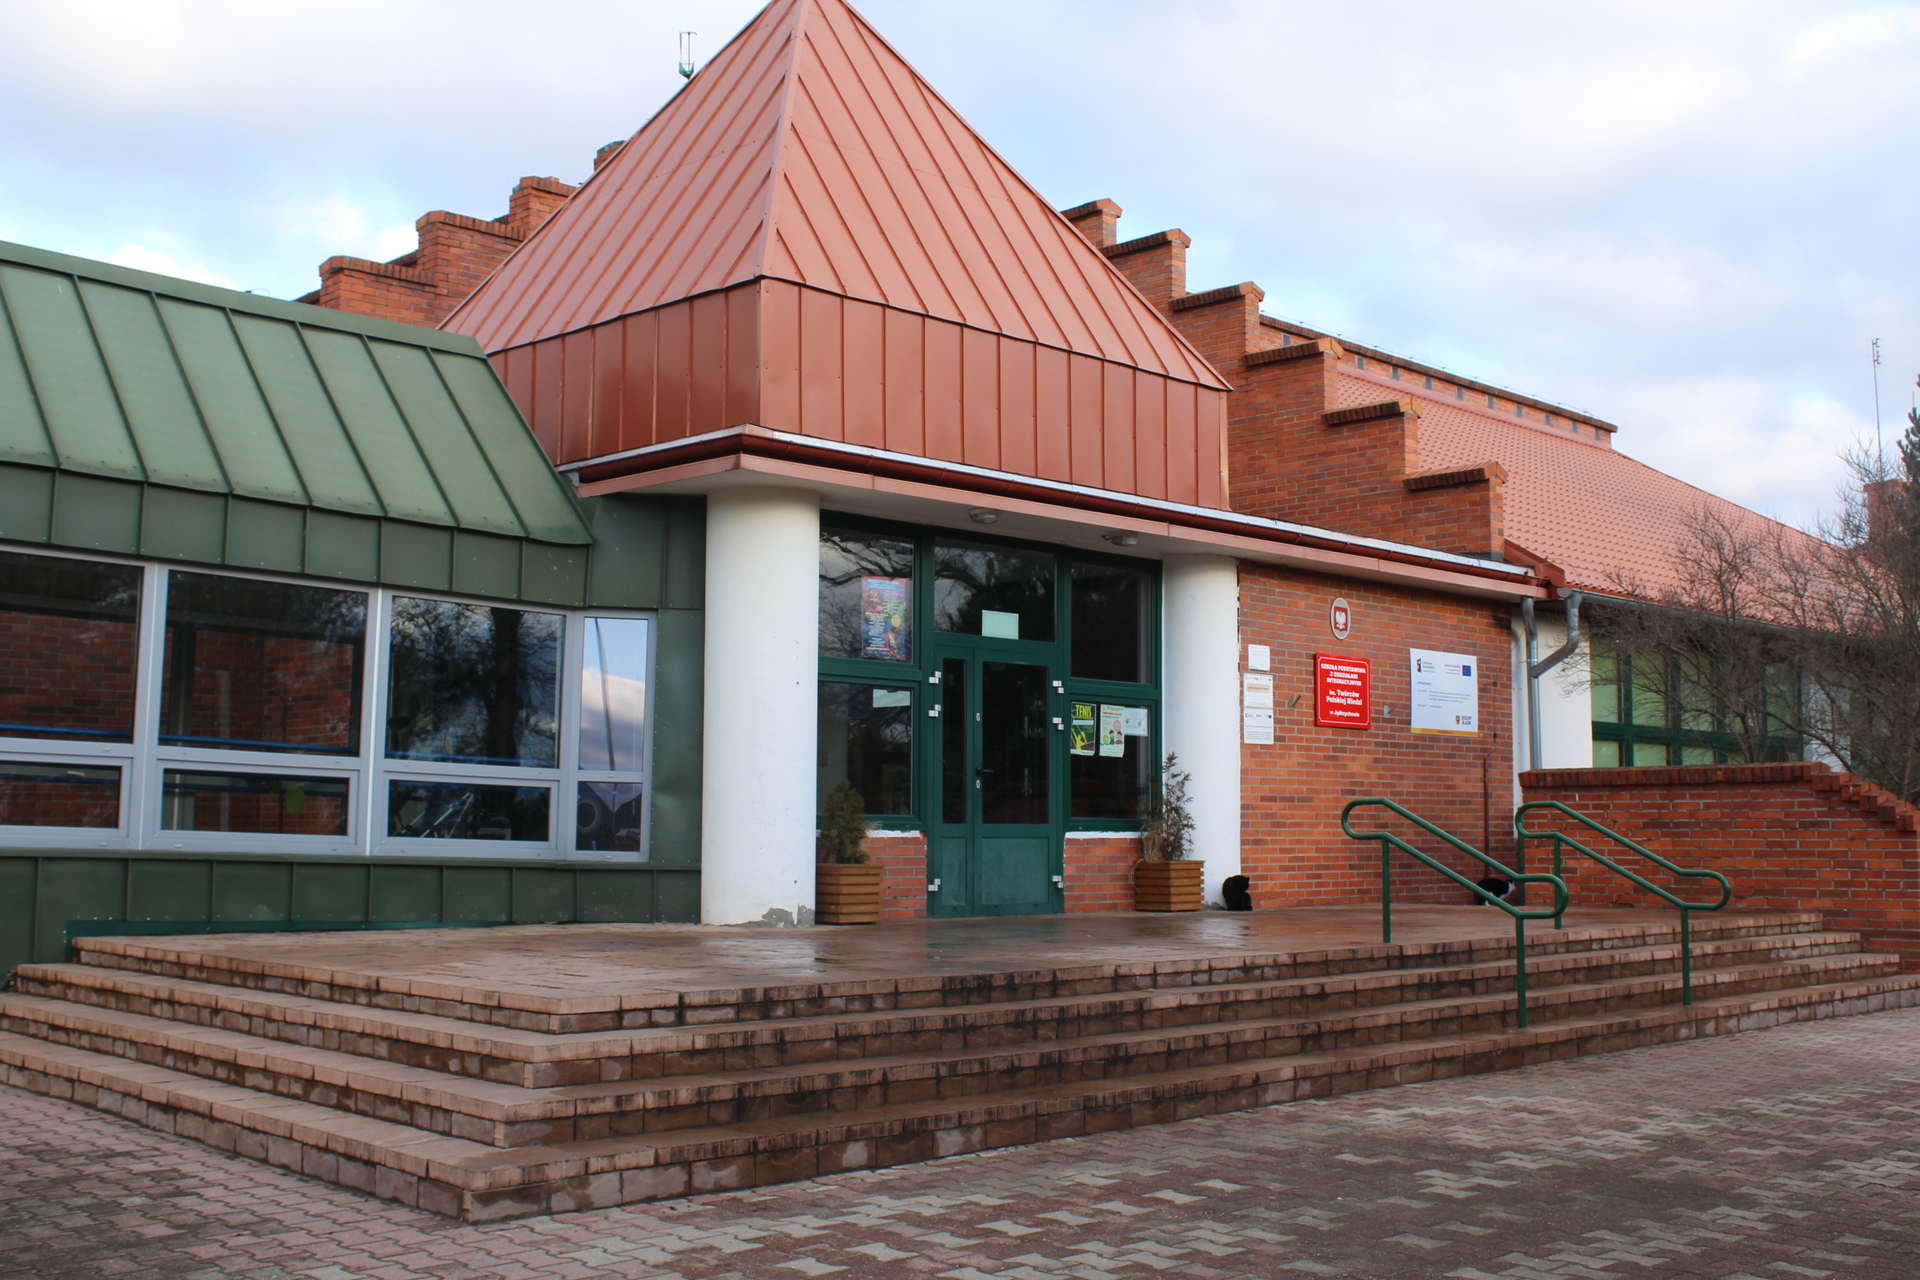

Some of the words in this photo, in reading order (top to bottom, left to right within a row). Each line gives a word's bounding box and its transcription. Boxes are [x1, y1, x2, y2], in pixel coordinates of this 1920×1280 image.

[1326, 678, 1362, 686] INTEGRACYJNYMI
[1326, 696, 1346, 705] Polskiej
[1075, 705, 1092, 718] TENIS
